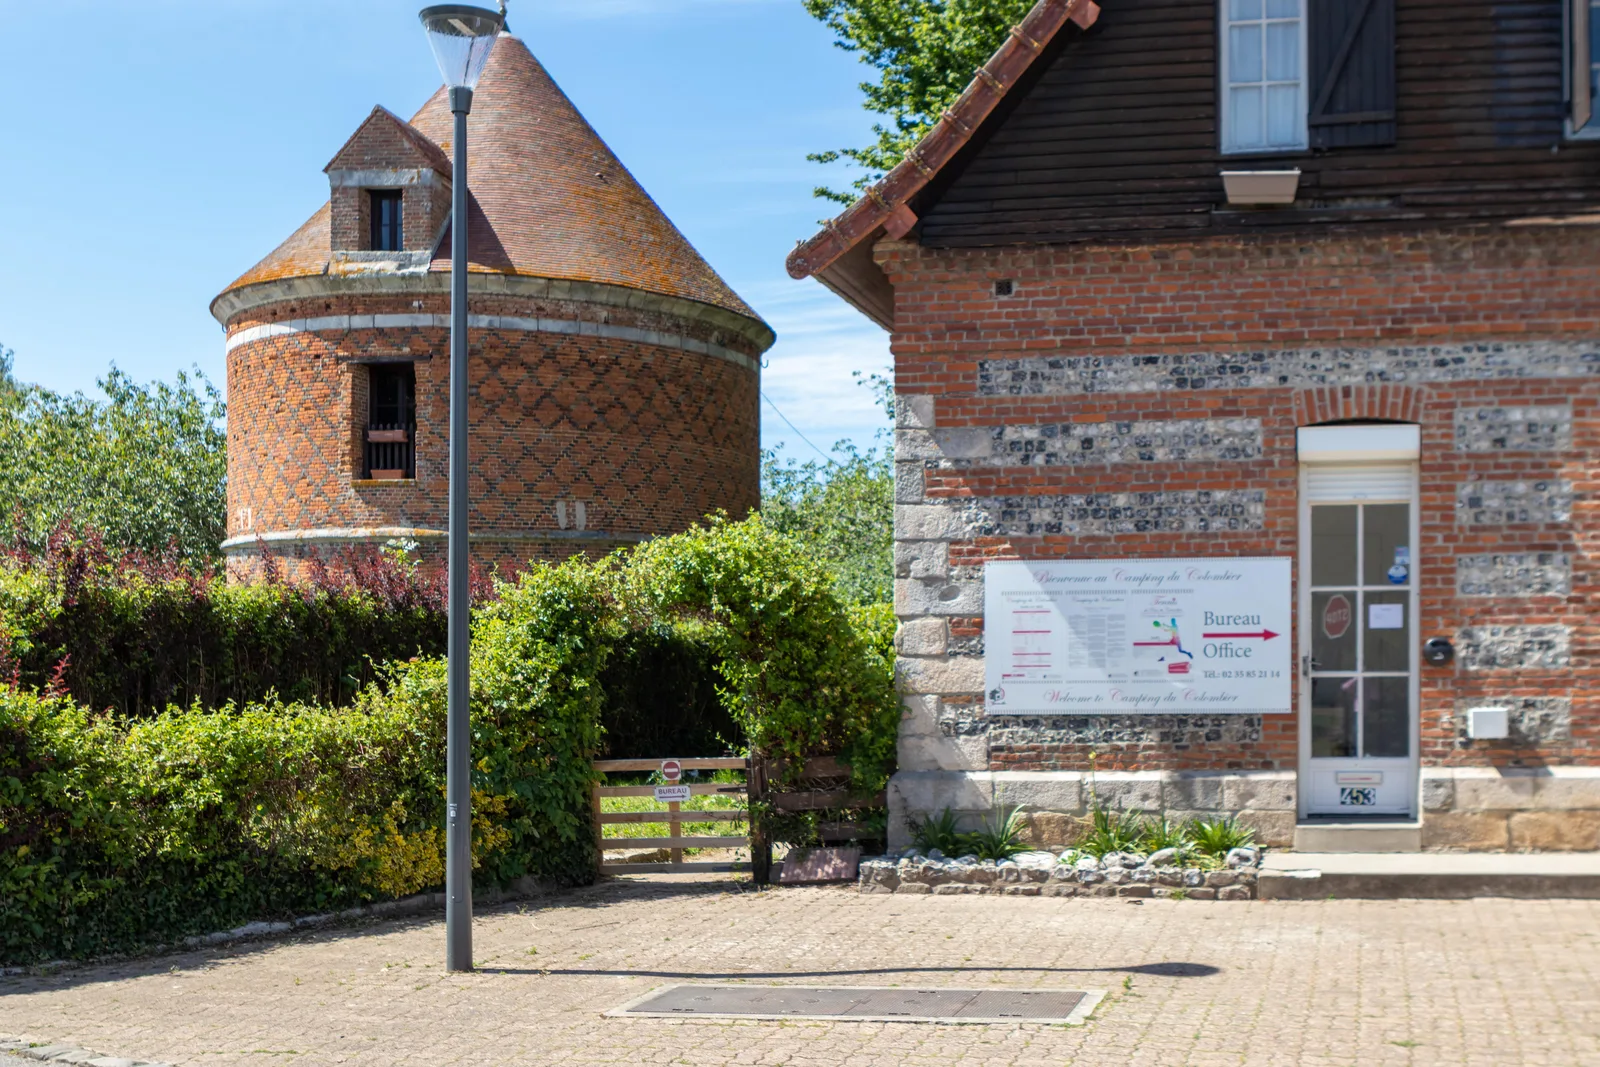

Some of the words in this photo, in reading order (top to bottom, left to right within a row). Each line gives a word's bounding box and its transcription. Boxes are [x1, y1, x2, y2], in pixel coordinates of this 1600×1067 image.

[1033, 568, 1092, 583] Bienvenue
[1113, 567, 1164, 587] Camping
[1167, 570, 1180, 581] du
[1185, 566, 1242, 581] Colombier
[1204, 611, 1261, 626] Bureau
[1203, 641, 1252, 659] Office
[1221, 670, 1233, 679] 02
[1234, 670, 1245, 679] 35
[1246, 670, 1257, 679] 85
[1258, 670, 1267, 679] 21
[1270, 670, 1281, 679] 14
[1043, 687, 1092, 703] Welcome
[1094, 694, 1104, 703] to
[1109, 688, 1161, 707] Camping
[1163, 691, 1177, 702] du
[1182, 688, 1239, 702] Colombier
[1340, 788, 1376, 805] 453
